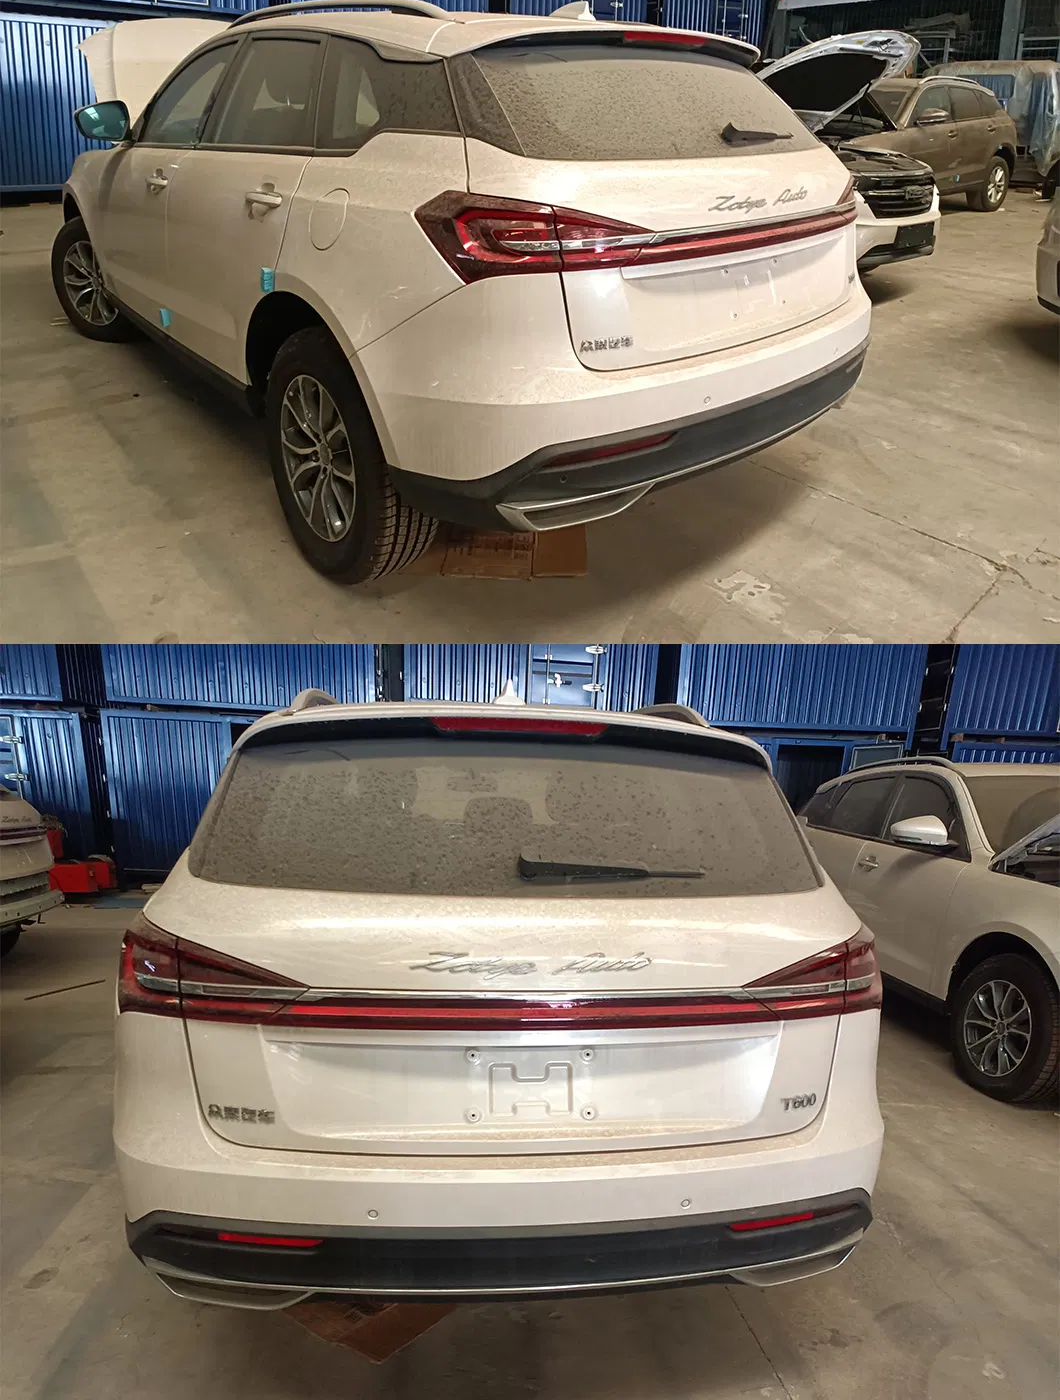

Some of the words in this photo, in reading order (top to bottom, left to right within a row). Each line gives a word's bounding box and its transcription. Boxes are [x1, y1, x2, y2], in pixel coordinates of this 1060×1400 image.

[708, 195, 768, 215] Zotye
[772, 186, 808, 207] Auto
[408, 951, 538, 981] Zotye
[551, 951, 653, 976] Auto
[780, 1092, 817, 1111] T600
